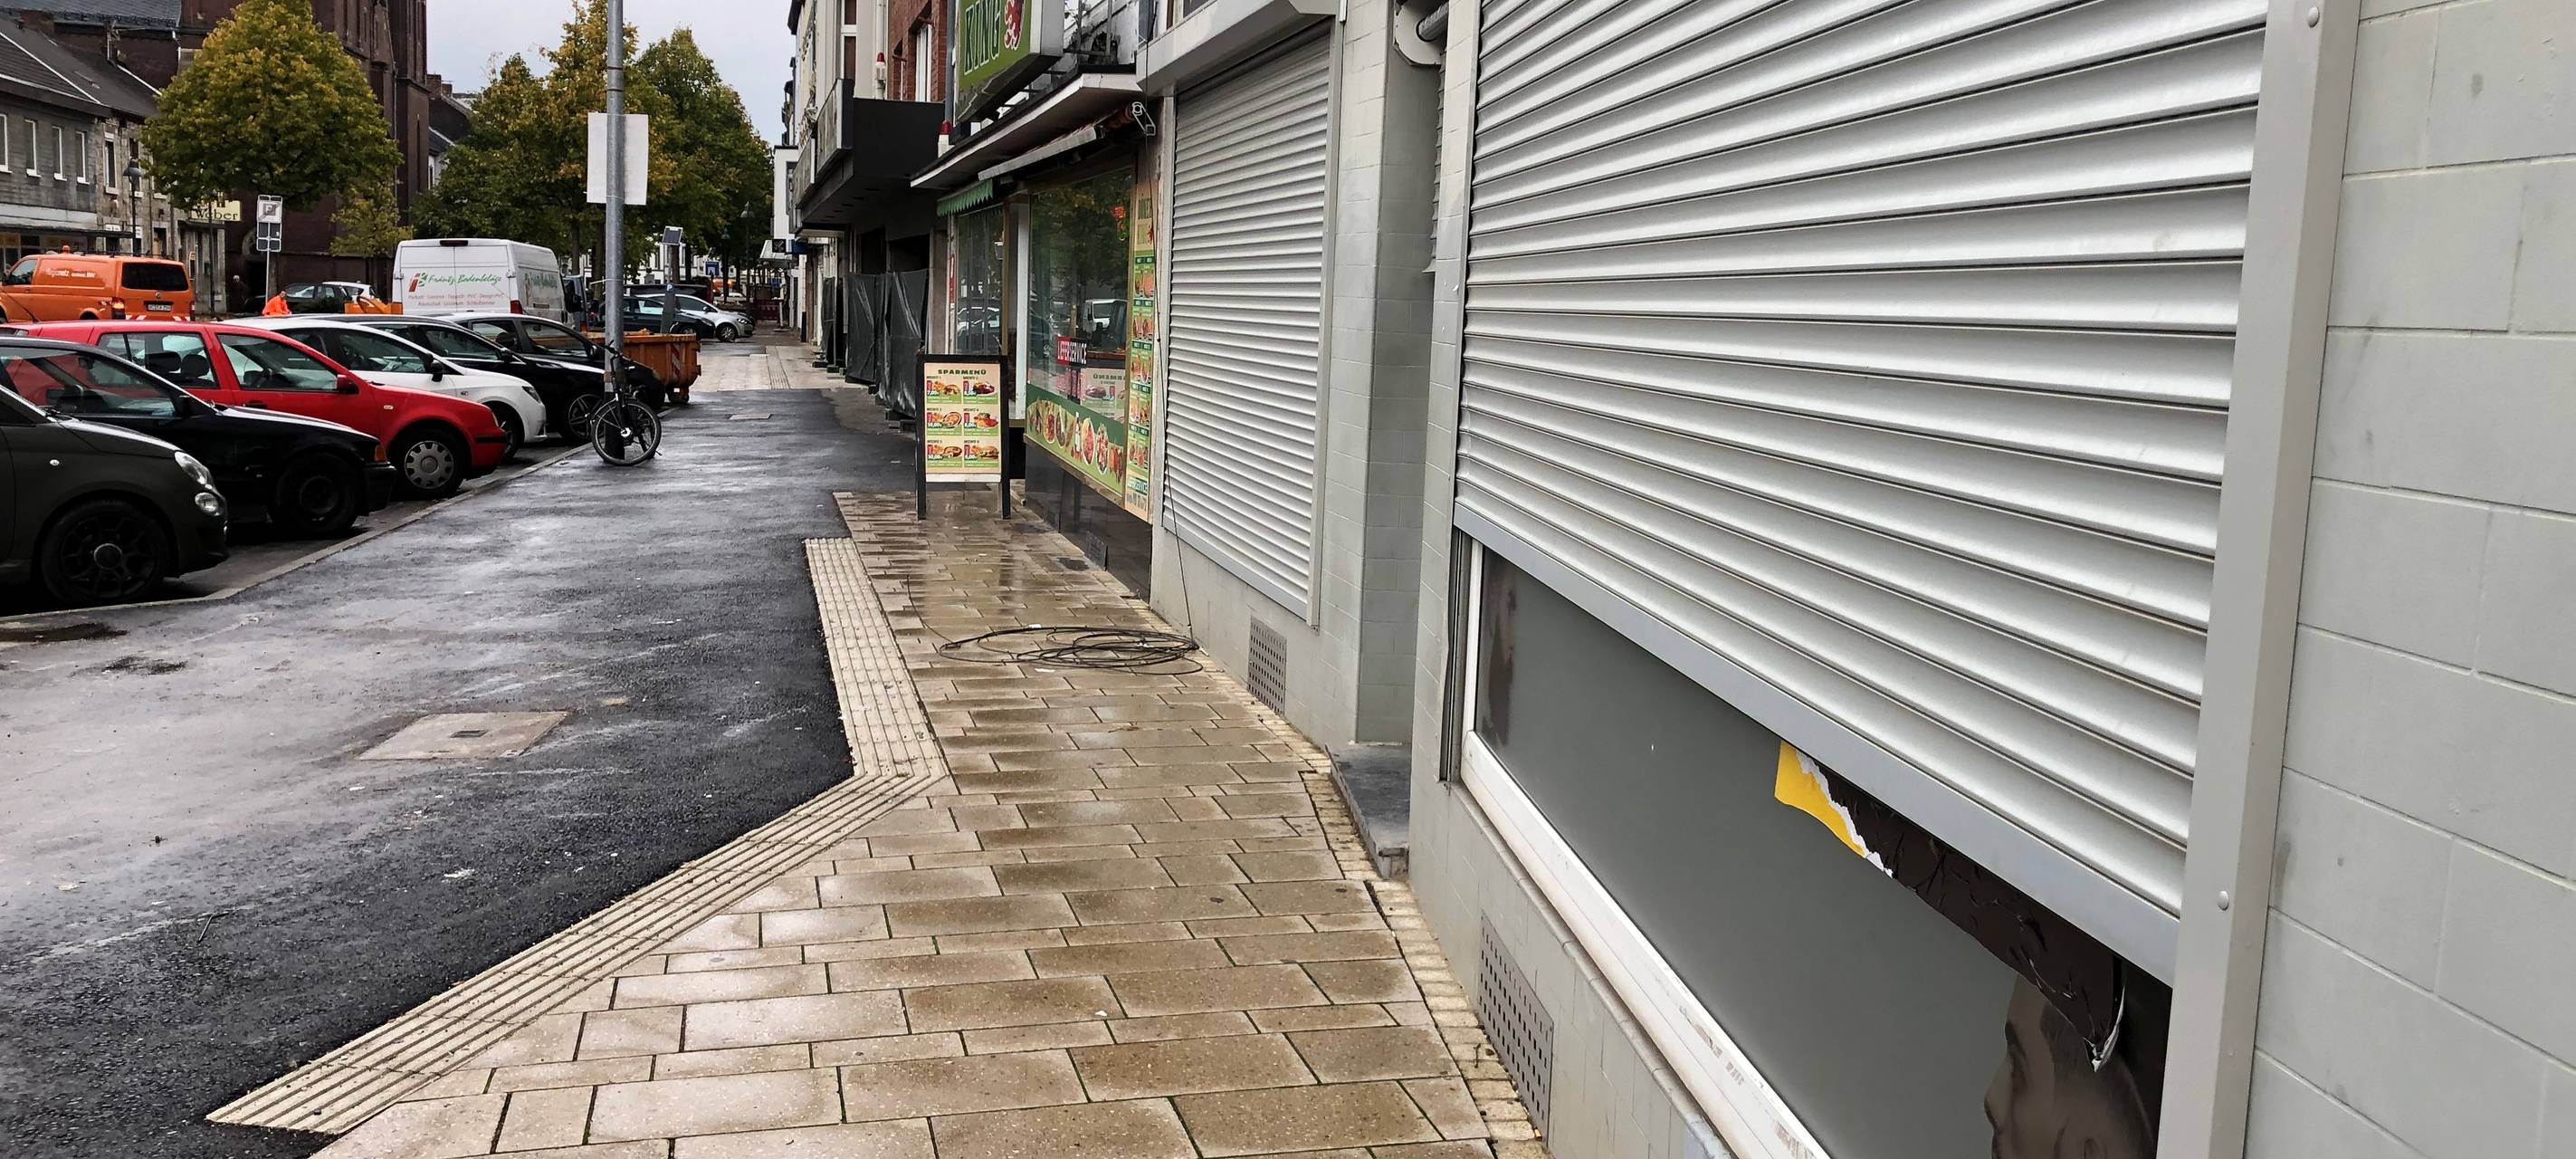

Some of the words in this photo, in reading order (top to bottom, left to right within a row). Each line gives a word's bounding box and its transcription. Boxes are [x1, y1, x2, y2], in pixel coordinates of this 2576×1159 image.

[964, 0, 1002, 75] KING
[194, 207, 239, 220] Weber
[666, 283, 673, 292] P
